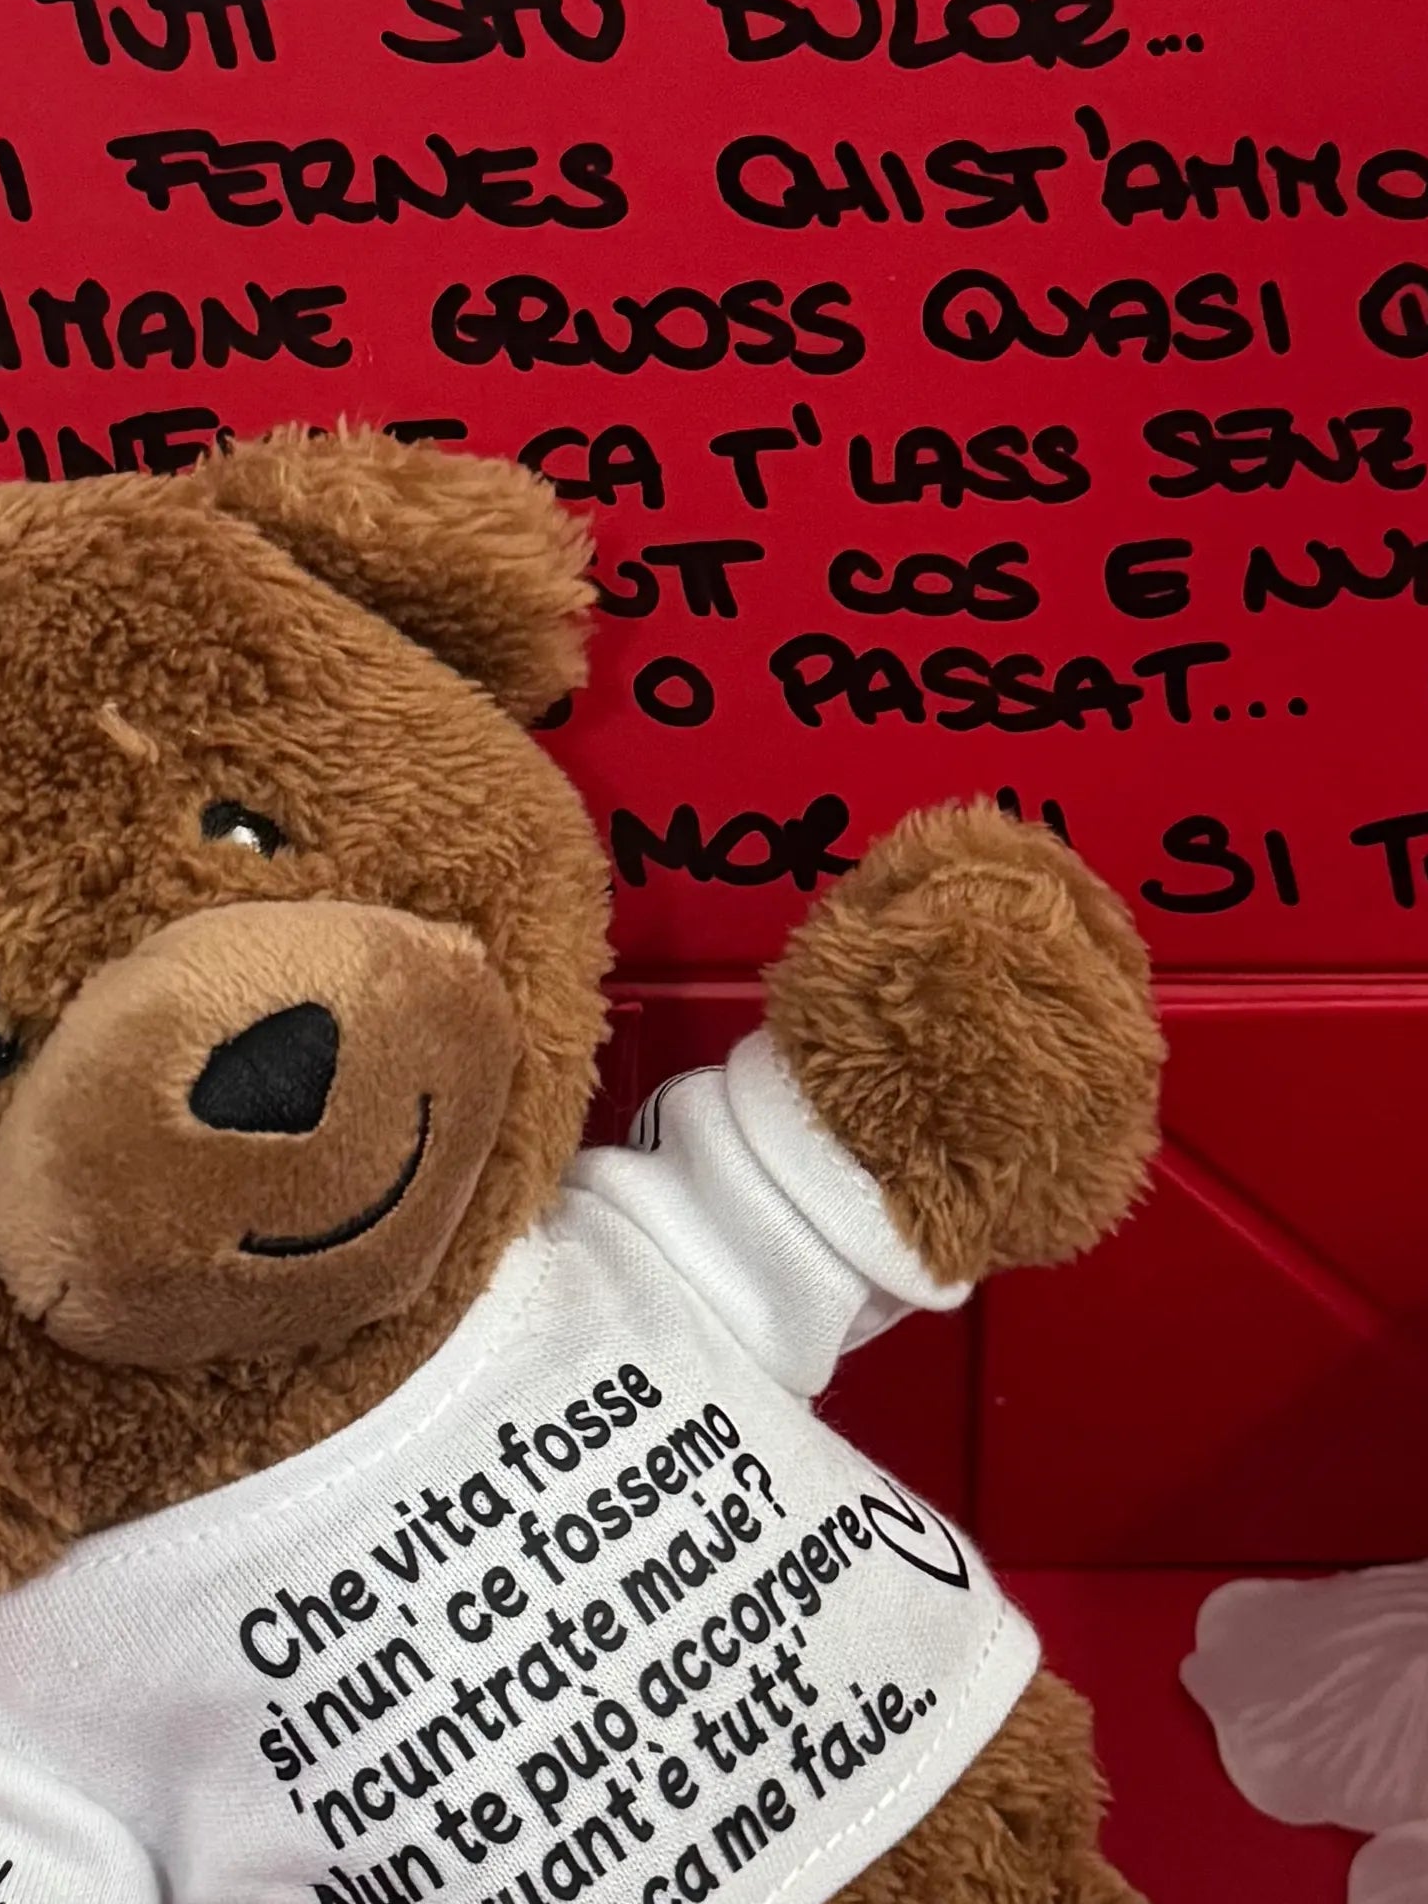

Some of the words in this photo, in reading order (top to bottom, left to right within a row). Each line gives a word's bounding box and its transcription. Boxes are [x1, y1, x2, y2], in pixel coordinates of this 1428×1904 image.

[432, 275, 865, 375] GRUOSS
[923, 269, 1290, 363] QUASI
[518, 425, 664, 509] CA
[1143, 407, 1427, 498] SENZ
[587, 540, 764, 618] UTT
[828, 542, 1039, 621] COS
[1105, 538, 1192, 619] E
[633, 656, 714, 727] O
[606, 793, 862, 893] MOR
[1140, 815, 1300, 914] SI
[240, 1570, 379, 1679] Che
[371, 1472, 516, 1586] vita
[498, 1364, 662, 1493] fosse
[447, 1566, 529, 1643] ce
[519, 1400, 740, 1586] fossemo
[618, 1452, 786, 1626] maje?
[434, 1792, 523, 1864] te
[516, 1689, 641, 1824] può
[639, 1501, 872, 1721] accorgere
[712, 1779, 796, 1872] me
